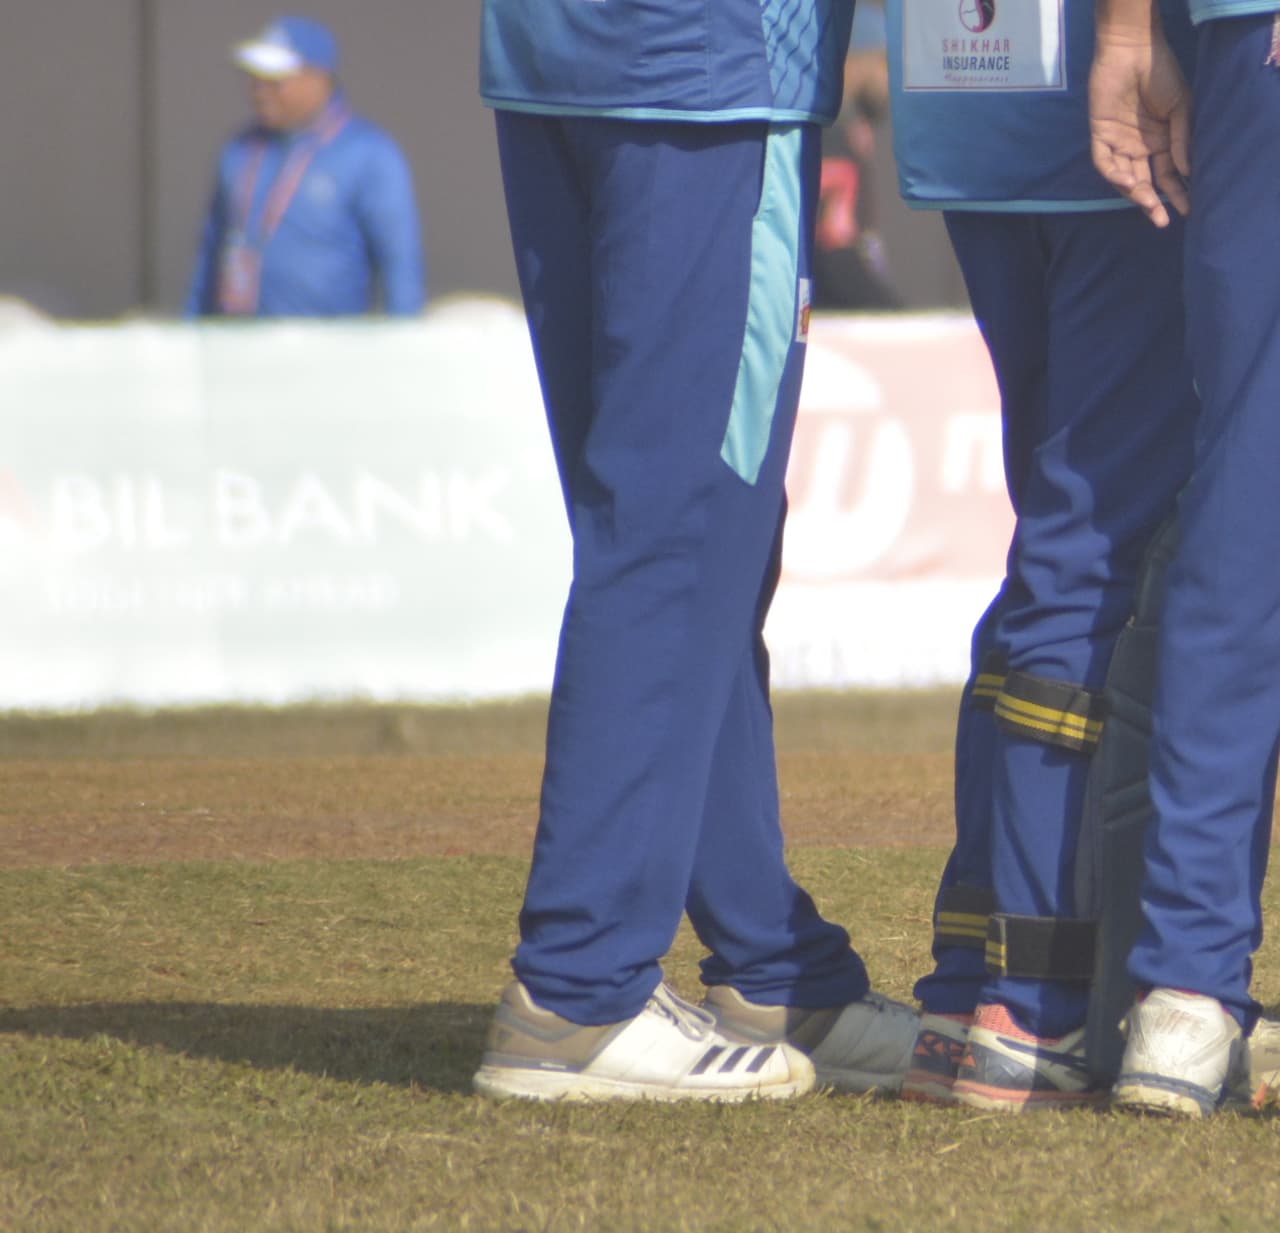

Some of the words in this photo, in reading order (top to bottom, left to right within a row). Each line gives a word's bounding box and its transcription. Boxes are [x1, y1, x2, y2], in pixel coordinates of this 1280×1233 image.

[942, 38, 1011, 53] SHIKHAR
[942, 55, 1011, 72] INSURANCE
[212, 465, 516, 545] BANK
